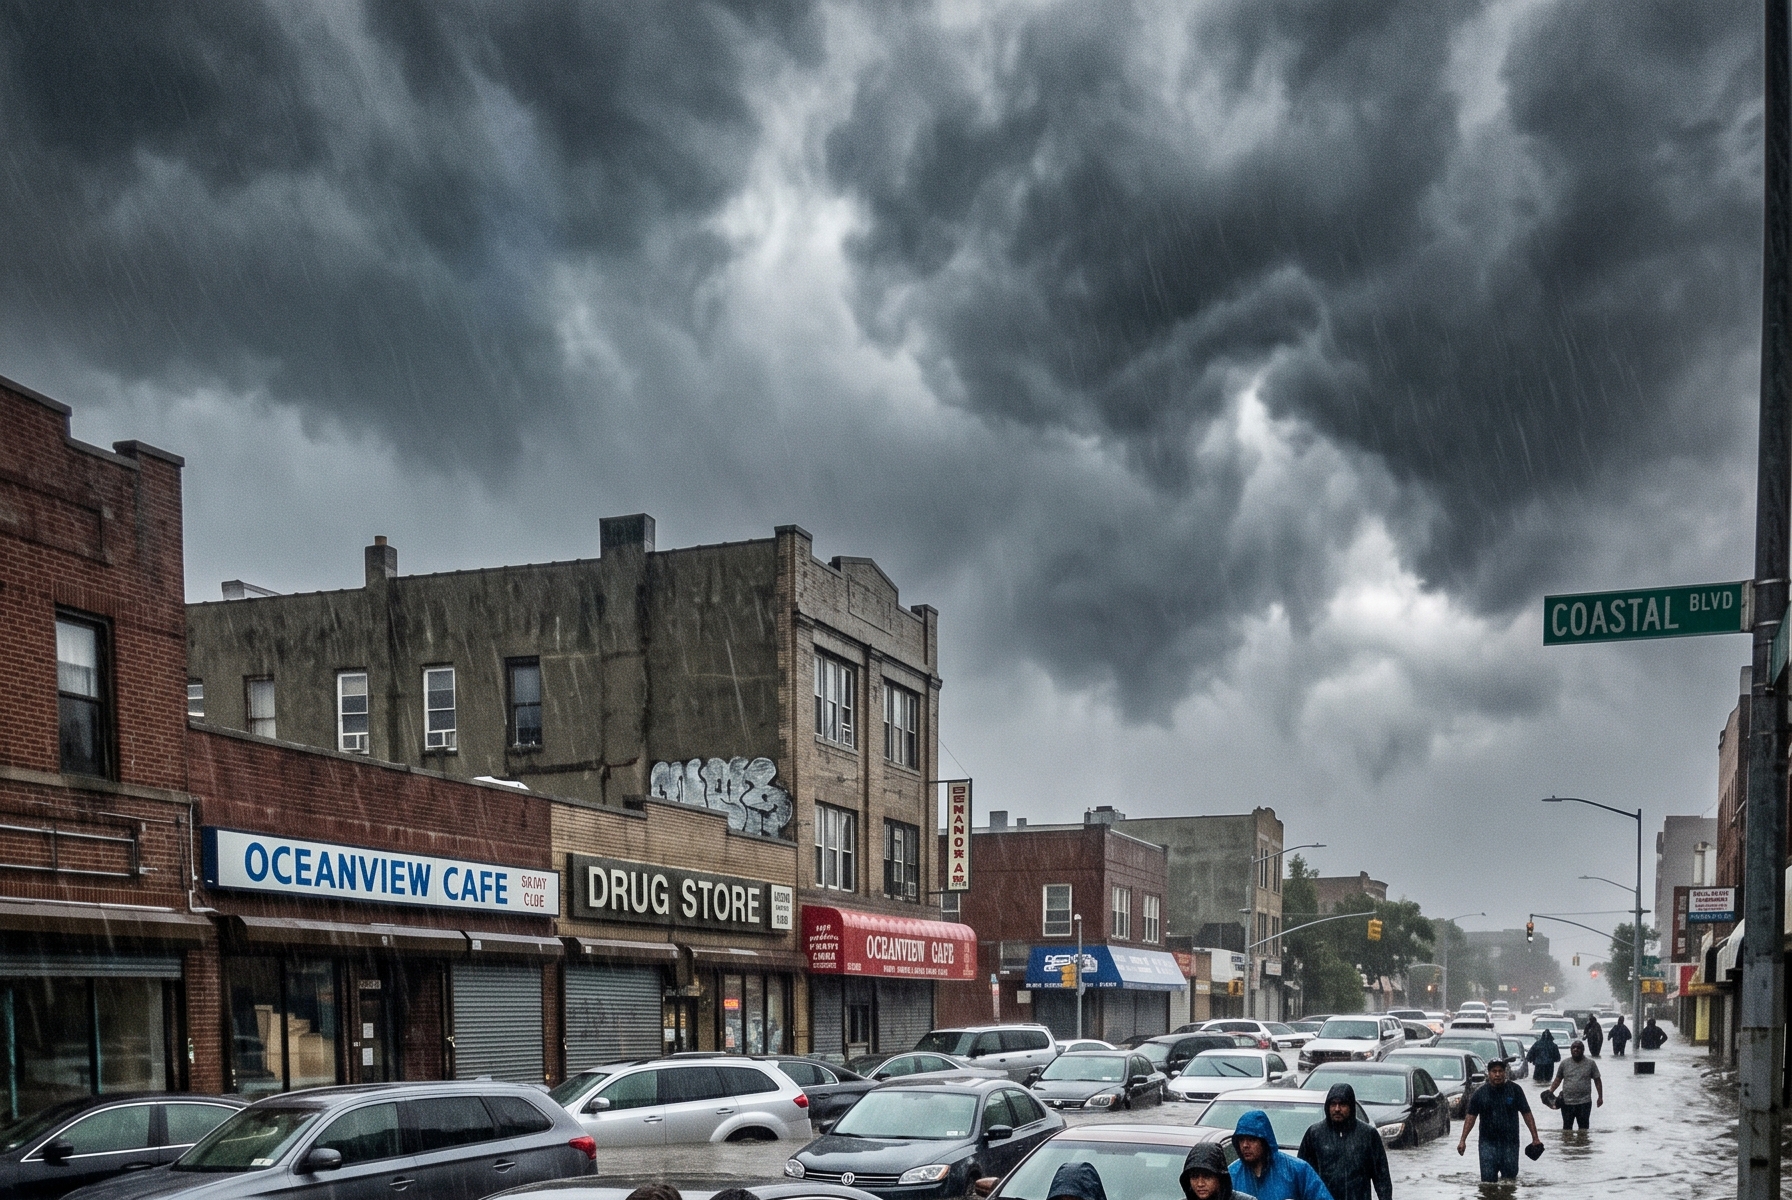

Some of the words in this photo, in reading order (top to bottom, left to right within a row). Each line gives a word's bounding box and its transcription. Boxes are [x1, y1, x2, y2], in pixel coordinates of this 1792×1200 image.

[1552, 596, 1680, 637] COASTAL
[1689, 591, 1733, 612] BLVD
[244, 842, 432, 897] OCEANVIEW
[443, 867, 508, 905] CAFE
[588, 865, 670, 915] DRUG
[681, 878, 760, 923] STORE
[866, 934, 926, 963] OCEANVIEW
[931, 941, 954, 965] CAFE
